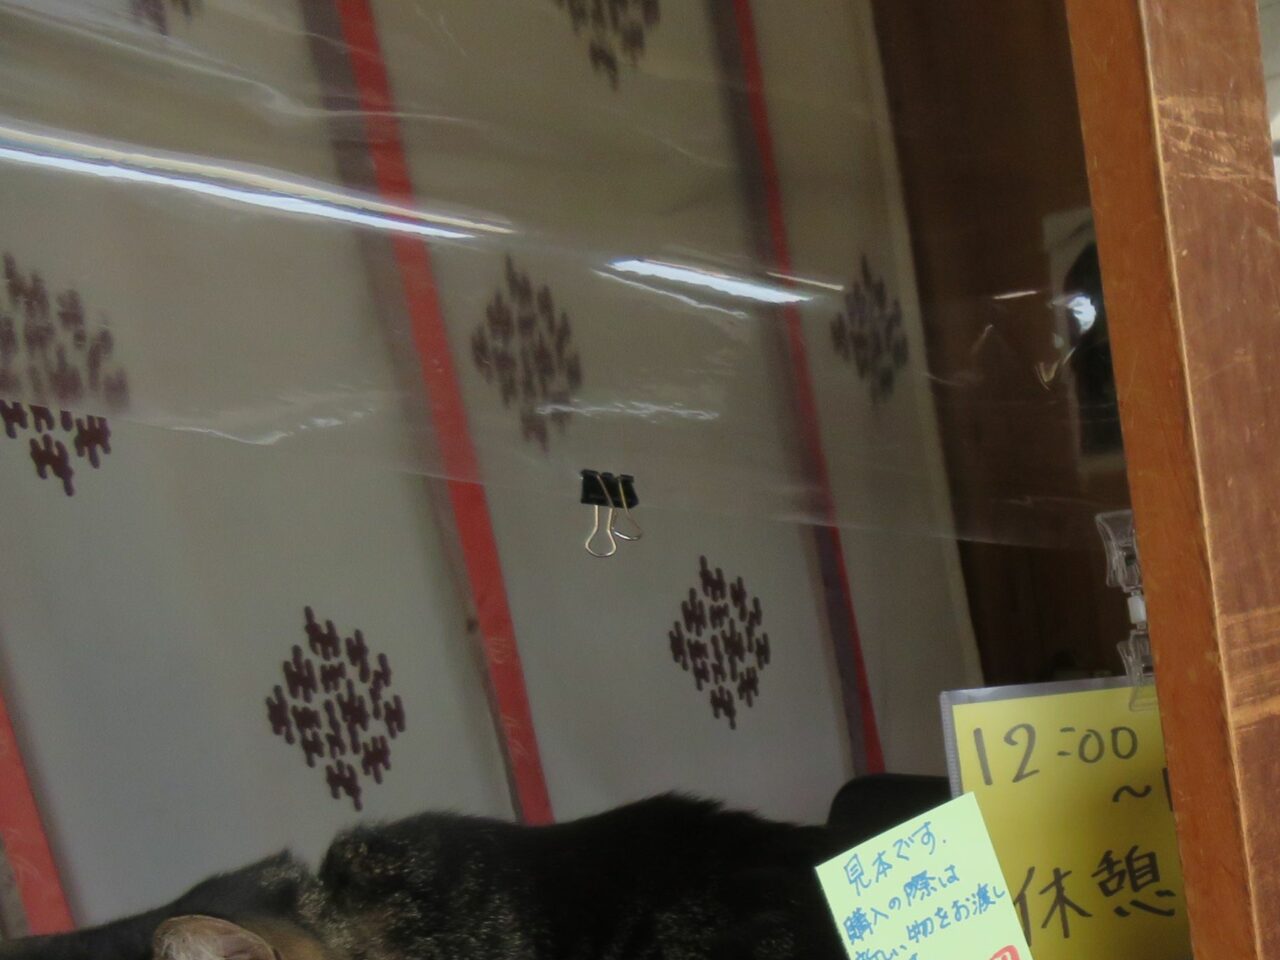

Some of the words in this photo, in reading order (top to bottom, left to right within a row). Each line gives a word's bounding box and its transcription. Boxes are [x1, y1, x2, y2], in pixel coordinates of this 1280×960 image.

[973, 723, 1139, 786] 12:00
[842, 864, 961, 945] 購入の際は
[1013, 845, 1176, 947] 休憩
